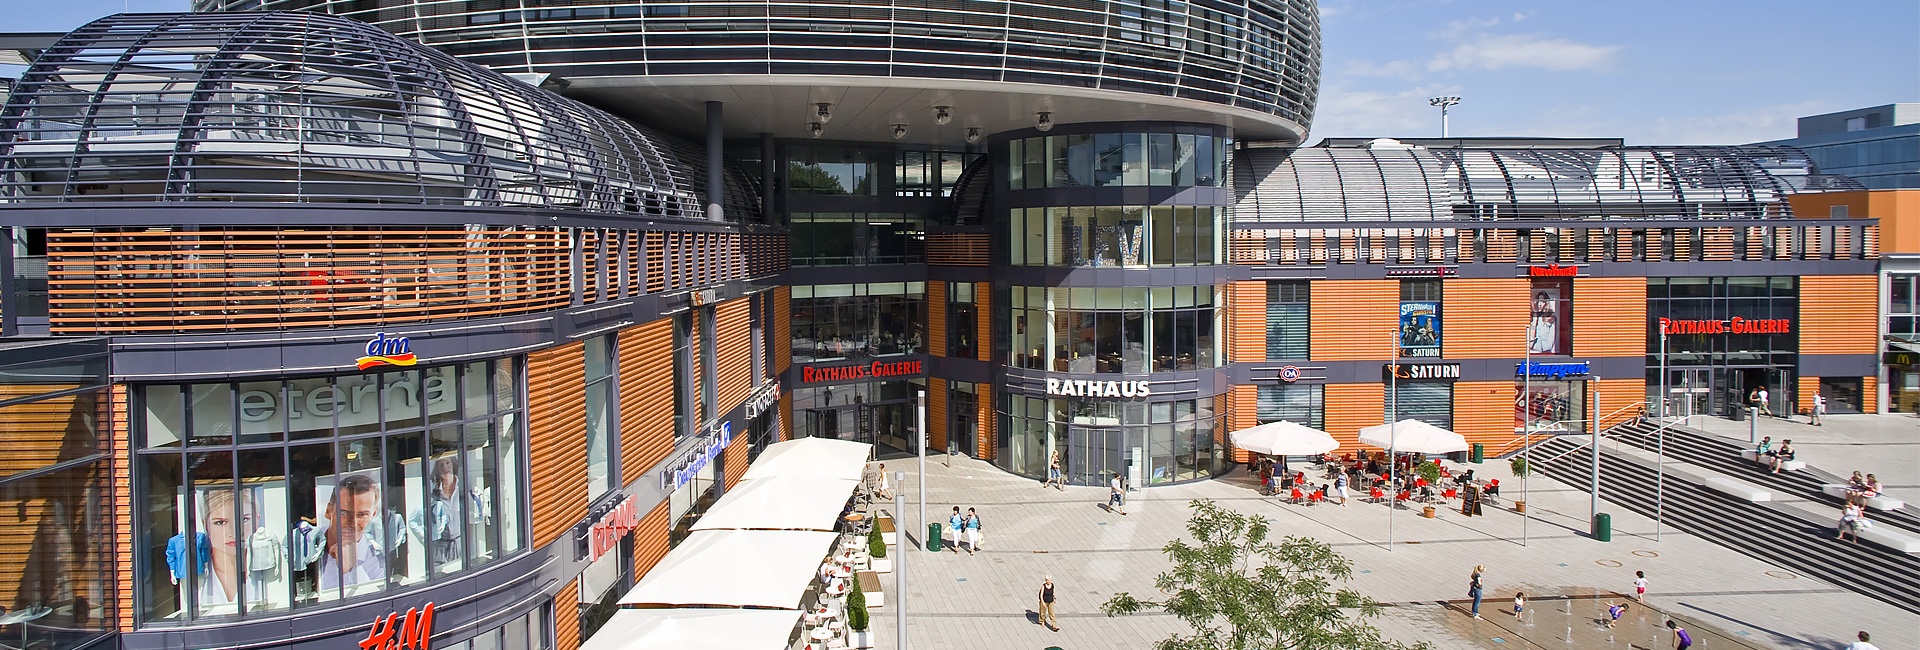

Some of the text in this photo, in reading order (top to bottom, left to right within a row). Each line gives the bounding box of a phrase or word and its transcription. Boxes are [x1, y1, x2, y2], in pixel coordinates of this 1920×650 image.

[366, 332, 409, 356] dm
[1412, 348, 1440, 357] SATURN
[803, 361, 922, 383] RATHAUS-GALERIE
[1411, 365, 1460, 378] SATURN
[241, 375, 445, 422] eterna
[1047, 378, 1151, 397] RATHAUS
[589, 494, 639, 562] REWE
